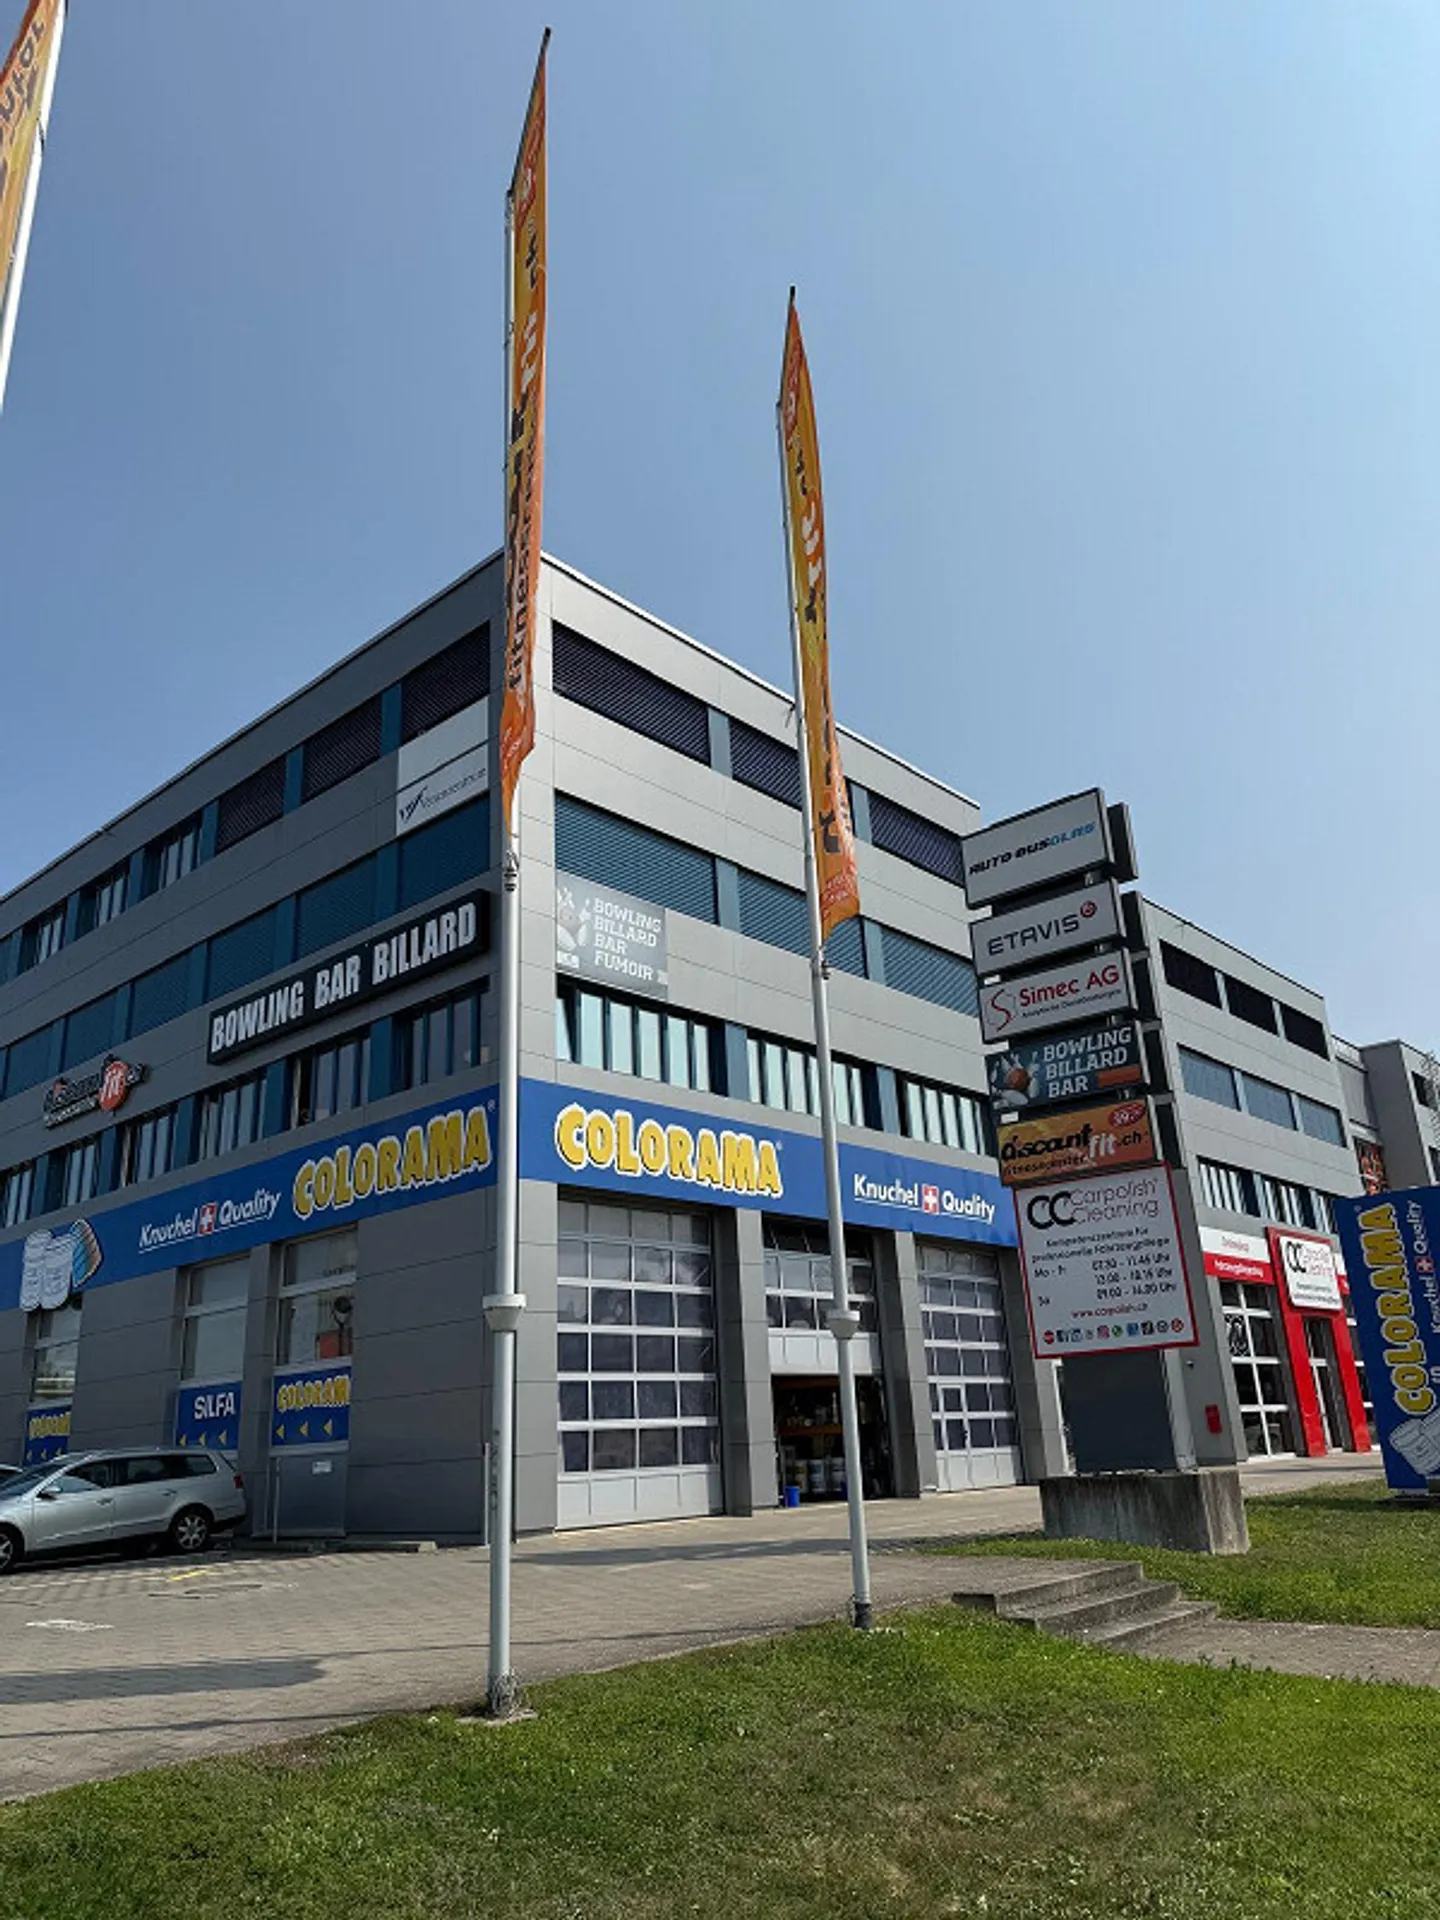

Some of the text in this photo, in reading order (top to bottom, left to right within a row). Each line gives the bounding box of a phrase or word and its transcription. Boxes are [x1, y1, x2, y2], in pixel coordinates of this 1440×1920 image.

[968, 851, 1012, 876] AUTO
[593, 897, 662, 933] BOWLING
[594, 915, 657, 947] BILLARD
[594, 932, 627, 955] BAR
[986, 913, 1080, 956] ETAVIS
[211, 902, 477, 1054] BOWLING BAR BILLARD
[594, 949, 654, 981] FUMOIR
[1019, 964, 1120, 1008] Simec AG
[1043, 1026, 1132, 1062] BOWLING
[1045, 1047, 1128, 1079] BILLARD
[1048, 1075, 1089, 1099] BAR
[293, 1105, 492, 1220] COLORAMA
[555, 1102, 785, 1200] COLORAMA
[853, 1173, 997, 1224] Knuchel Quality
[1070, 1180, 1155, 1207] Carpolish
[139, 1188, 283, 1248] Knuchel Quality
[1071, 1199, 1159, 1225] Cleaning
[1406, 1200, 1428, 1255] Quality
[1357, 1202, 1437, 1416] COLORAMA
[193, 1392, 236, 1420] SILFA
